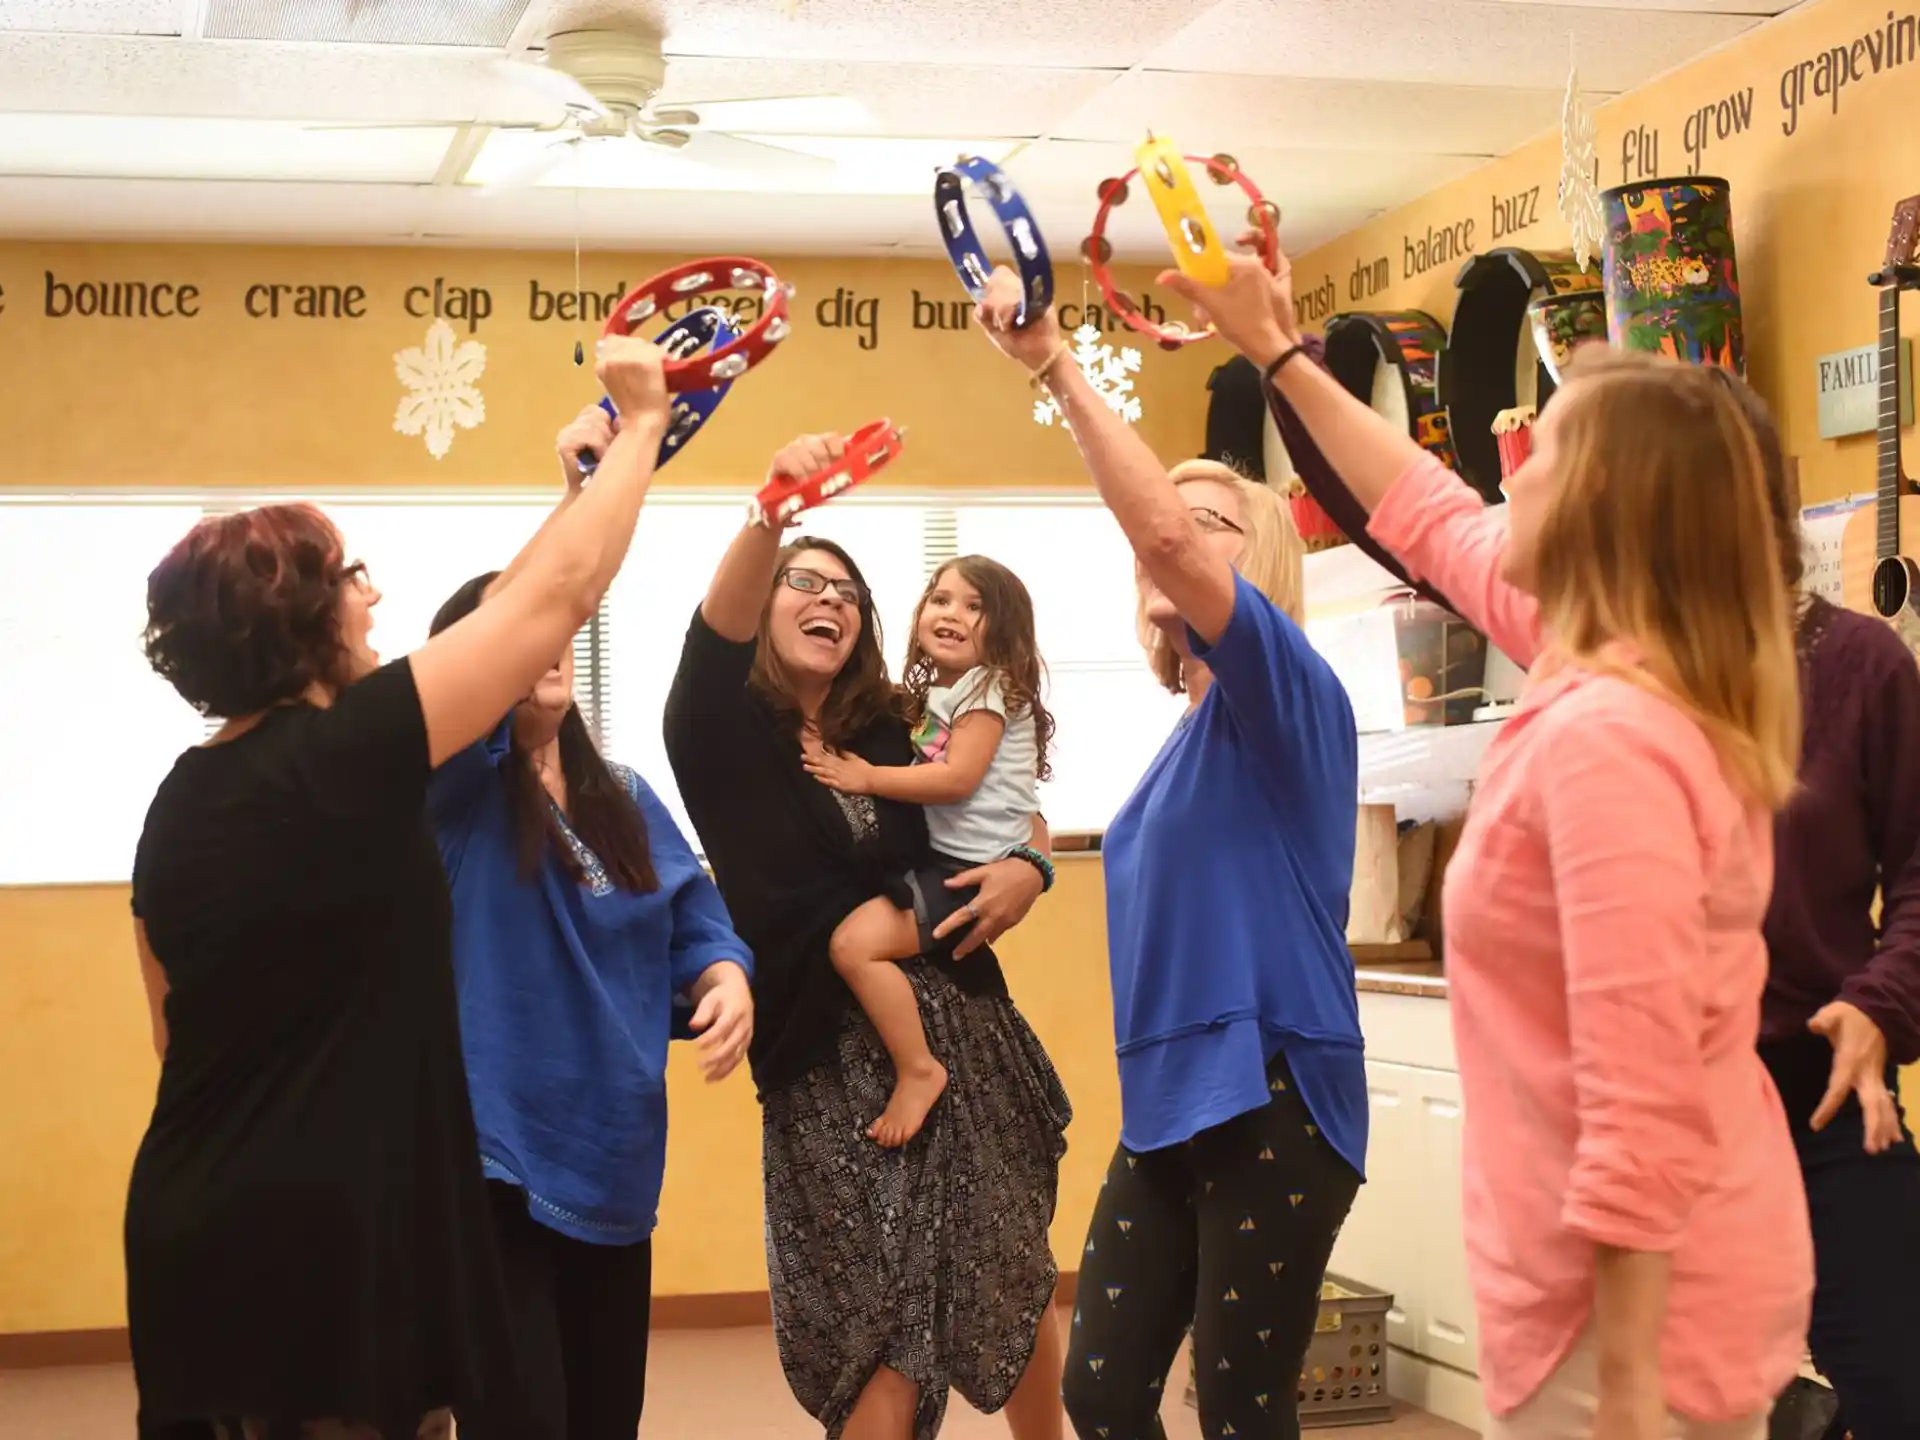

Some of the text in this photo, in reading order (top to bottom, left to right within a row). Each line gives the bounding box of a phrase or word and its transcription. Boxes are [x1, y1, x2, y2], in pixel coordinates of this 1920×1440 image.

[1349, 255, 1390, 302] drum
[1403, 217, 1475, 281] balance
[1491, 185, 1541, 241] buzz
[1621, 123, 1659, 183] fly
[1683, 84, 1754, 176] grow
[1780, 10, 1920, 137] grapevin
[44, 269, 200, 318] bounce
[244, 281, 367, 318] crane
[403, 277, 493, 333] clap
[528, 279, 627, 322] bend
[815, 286, 880, 351] dig
[1819, 352, 1878, 393] FAMIL
